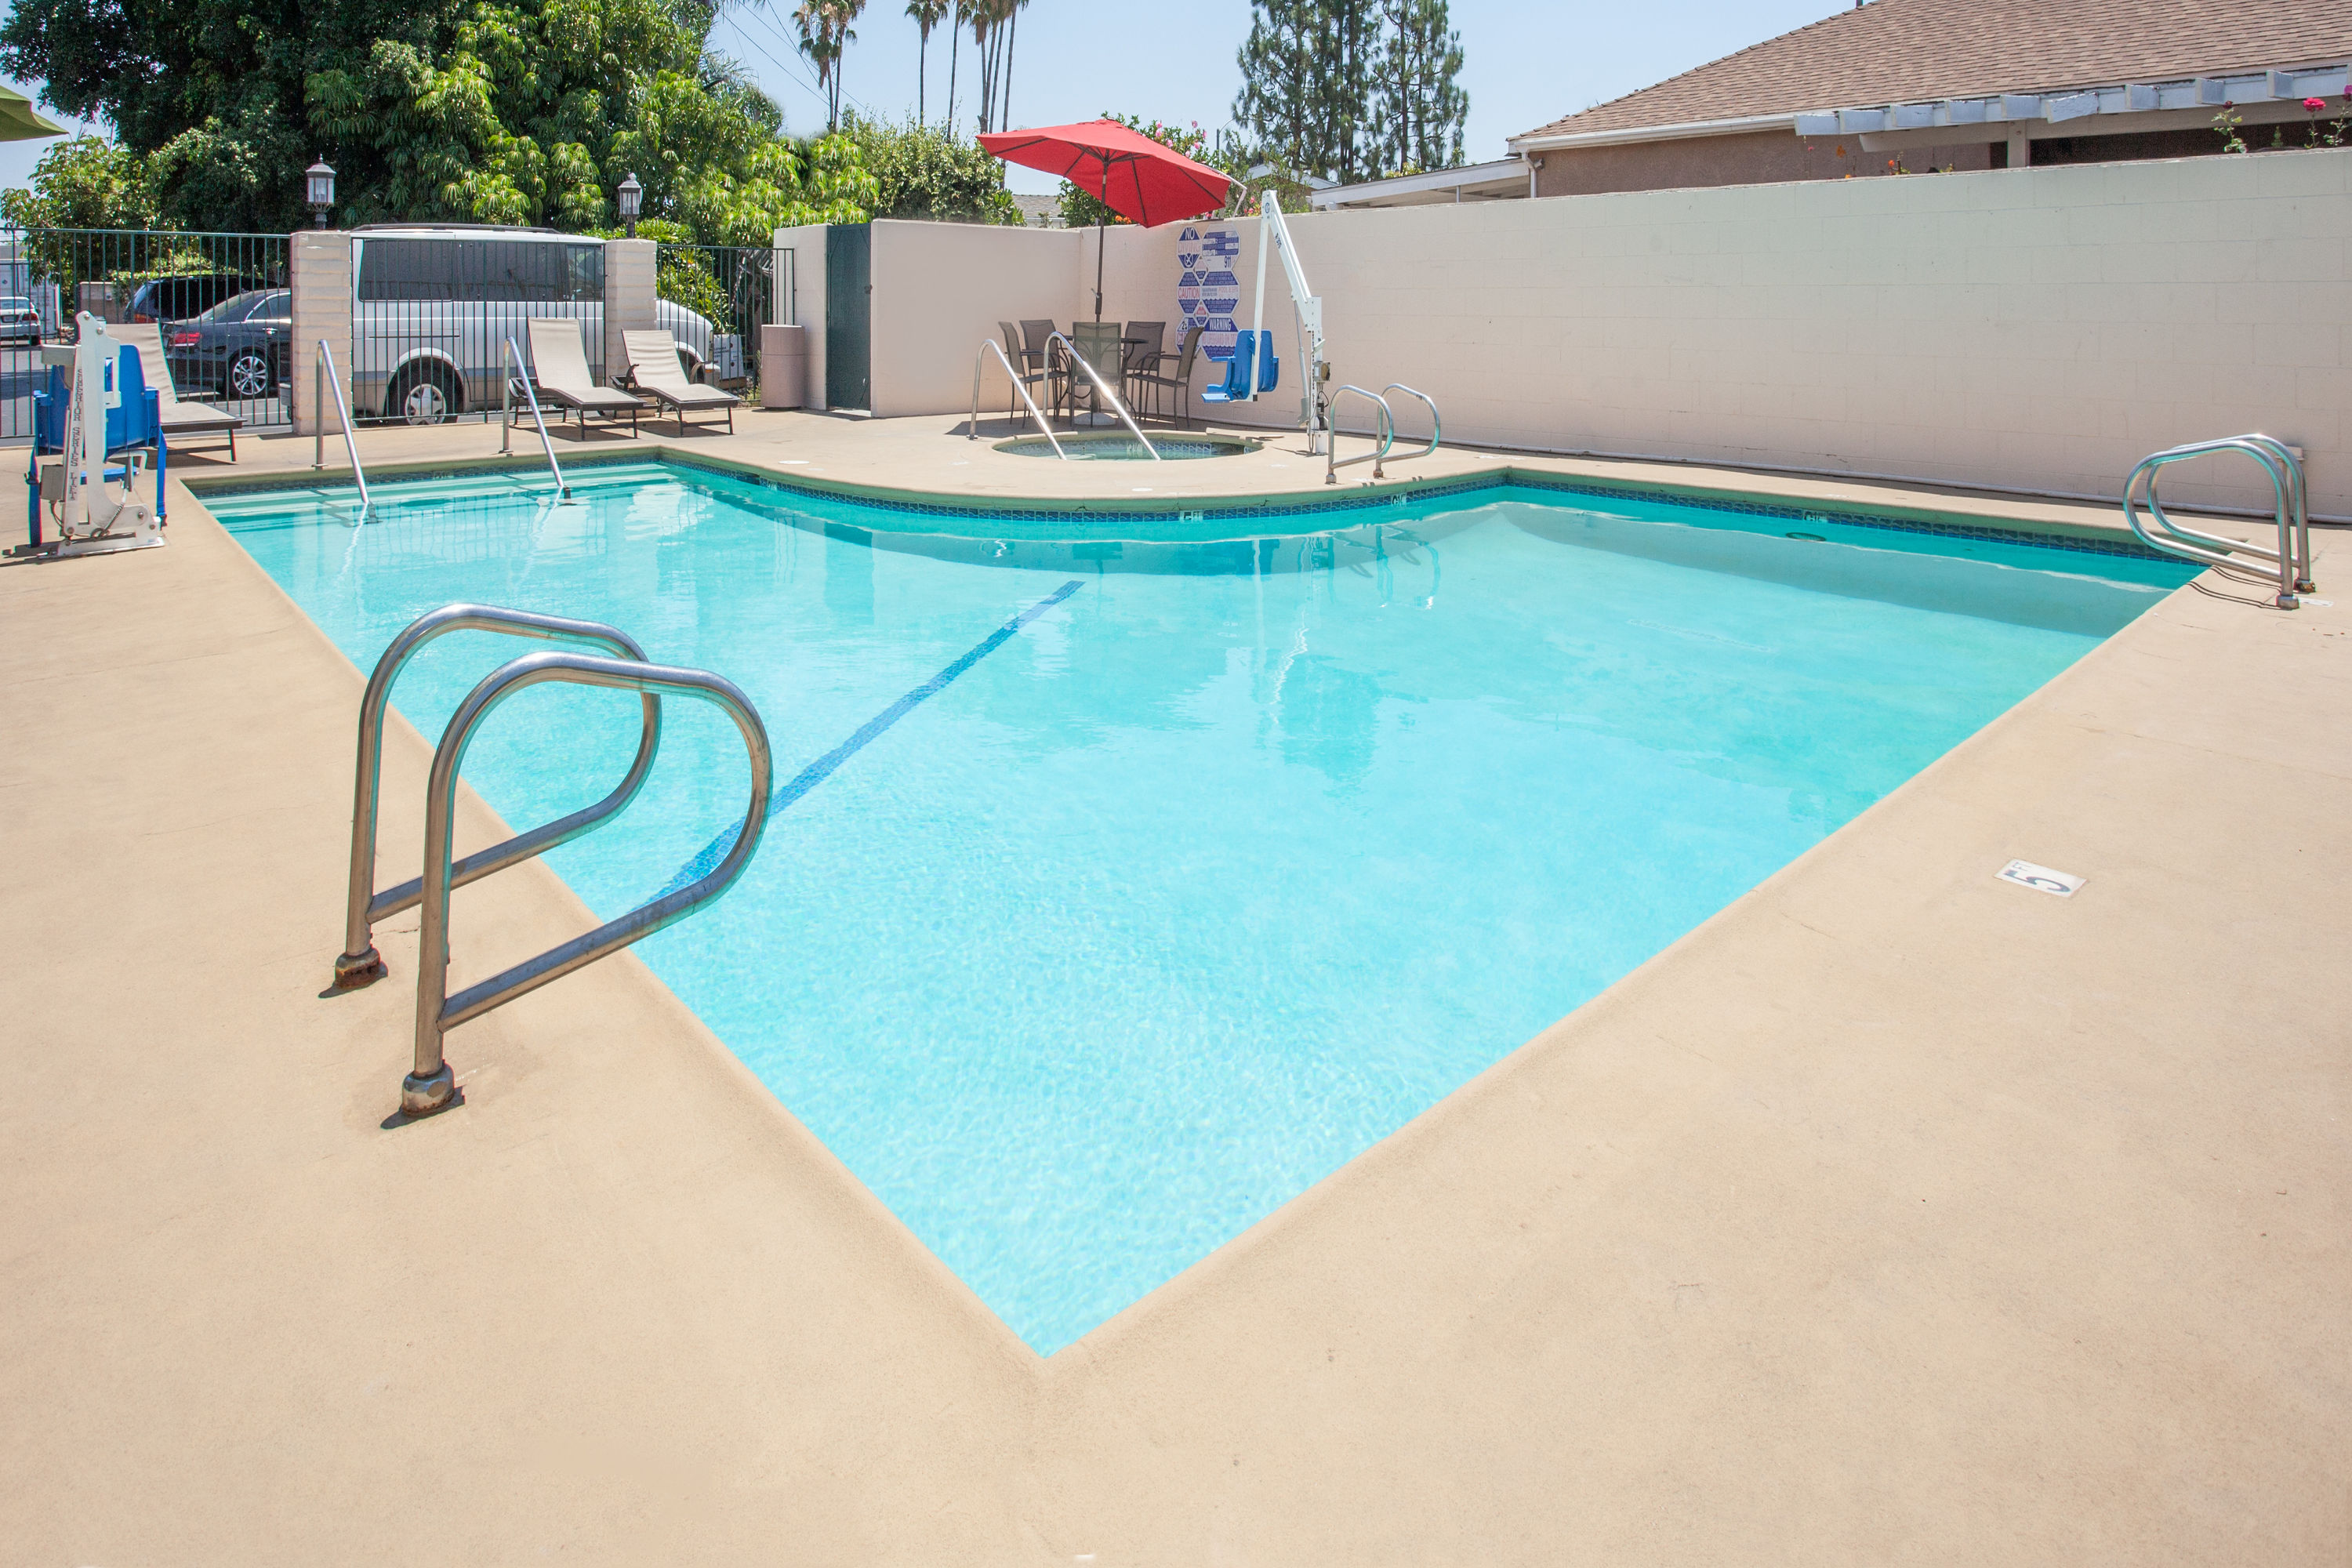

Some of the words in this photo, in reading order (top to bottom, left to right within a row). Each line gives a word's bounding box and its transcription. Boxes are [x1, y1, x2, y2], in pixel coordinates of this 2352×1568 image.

[1185, 227, 1195, 240] NO
[1178, 287, 1200, 299] CAUTION
[1210, 318, 1232, 331] WARNING
[71, 426, 80, 466] SERIES
[2004, 869, 2071, 892] 5
